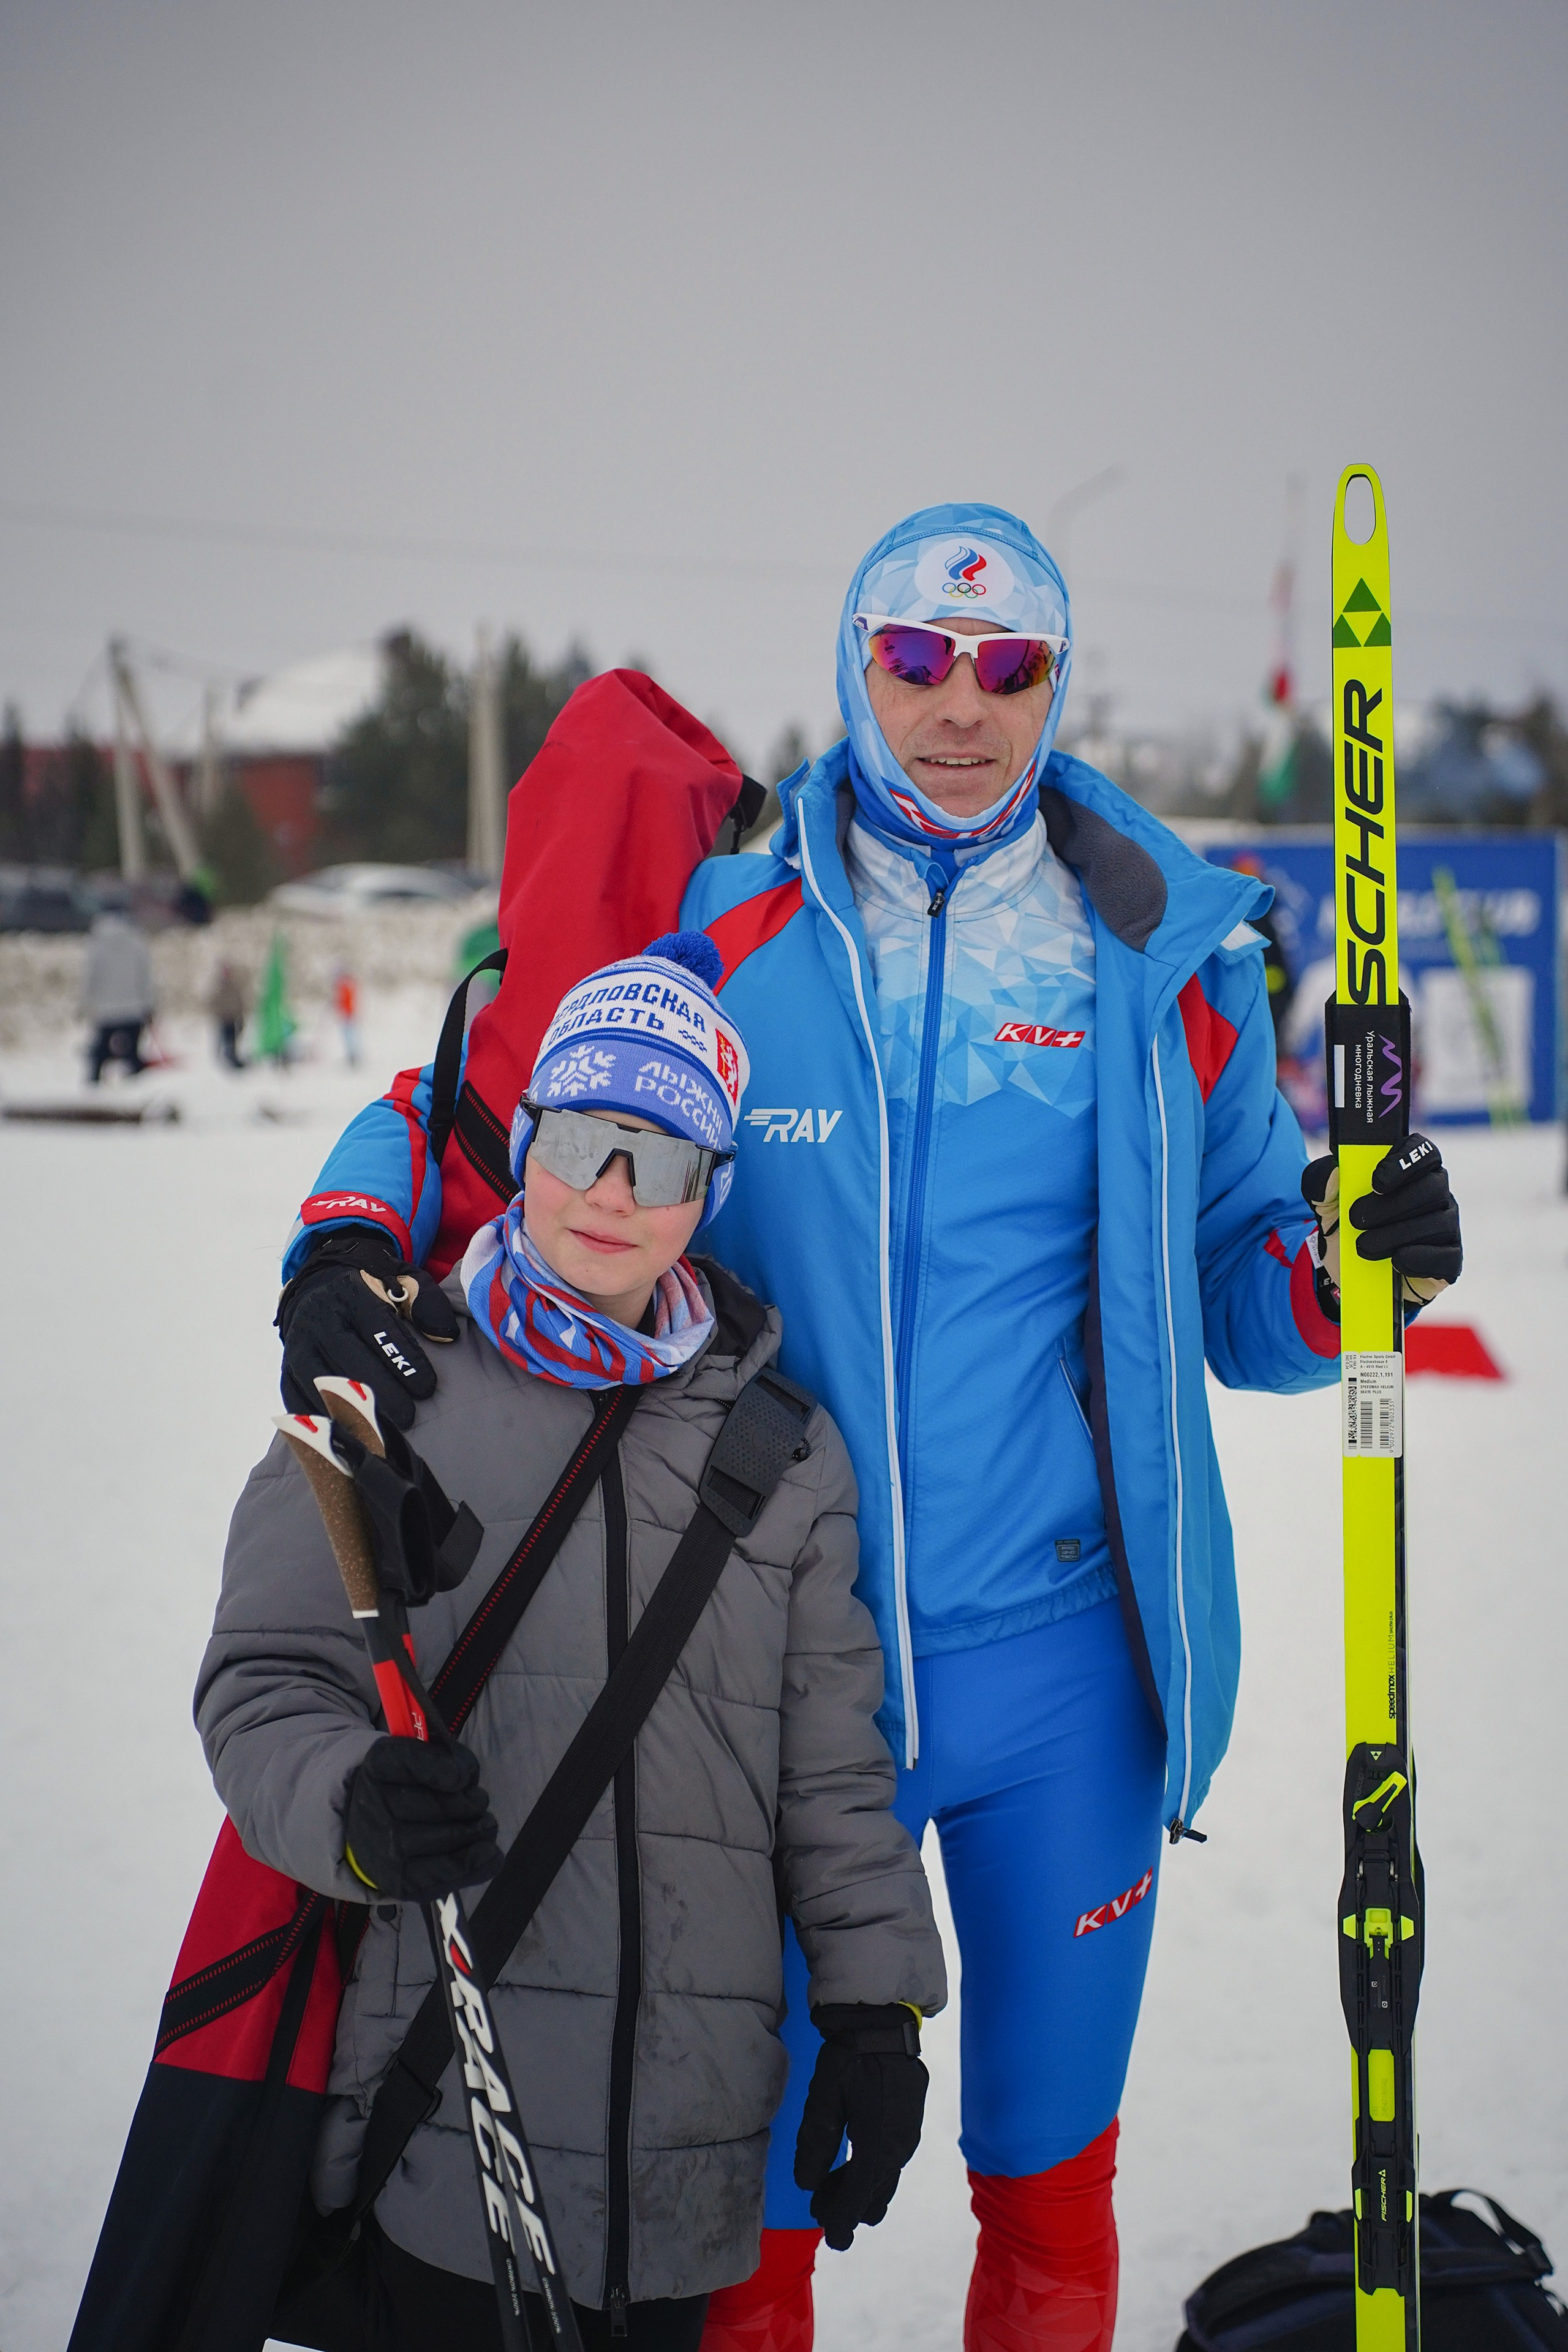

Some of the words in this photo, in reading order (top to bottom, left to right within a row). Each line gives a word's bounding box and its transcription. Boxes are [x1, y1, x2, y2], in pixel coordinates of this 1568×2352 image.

[1344, 679, 1387, 1005] SCHER
[548, 1006, 665, 1047] ОБЛАСТЬ
[997, 1023, 1083, 1047] KV+
[1365, 1030, 1375, 1081] Уральская
[639, 1061, 722, 1134] ЛЫЖНЯ
[744, 1109, 843, 1143] RAY
[1399, 1141, 1433, 1170] LEKI
[311, 1196, 386, 1213] RAY
[374, 1331, 417, 1378] LEKI
[1075, 1871, 1153, 1937] KV+
[506, 2258, 516, 2293] CARBON
[543, 2277, 554, 2310] CARBON
